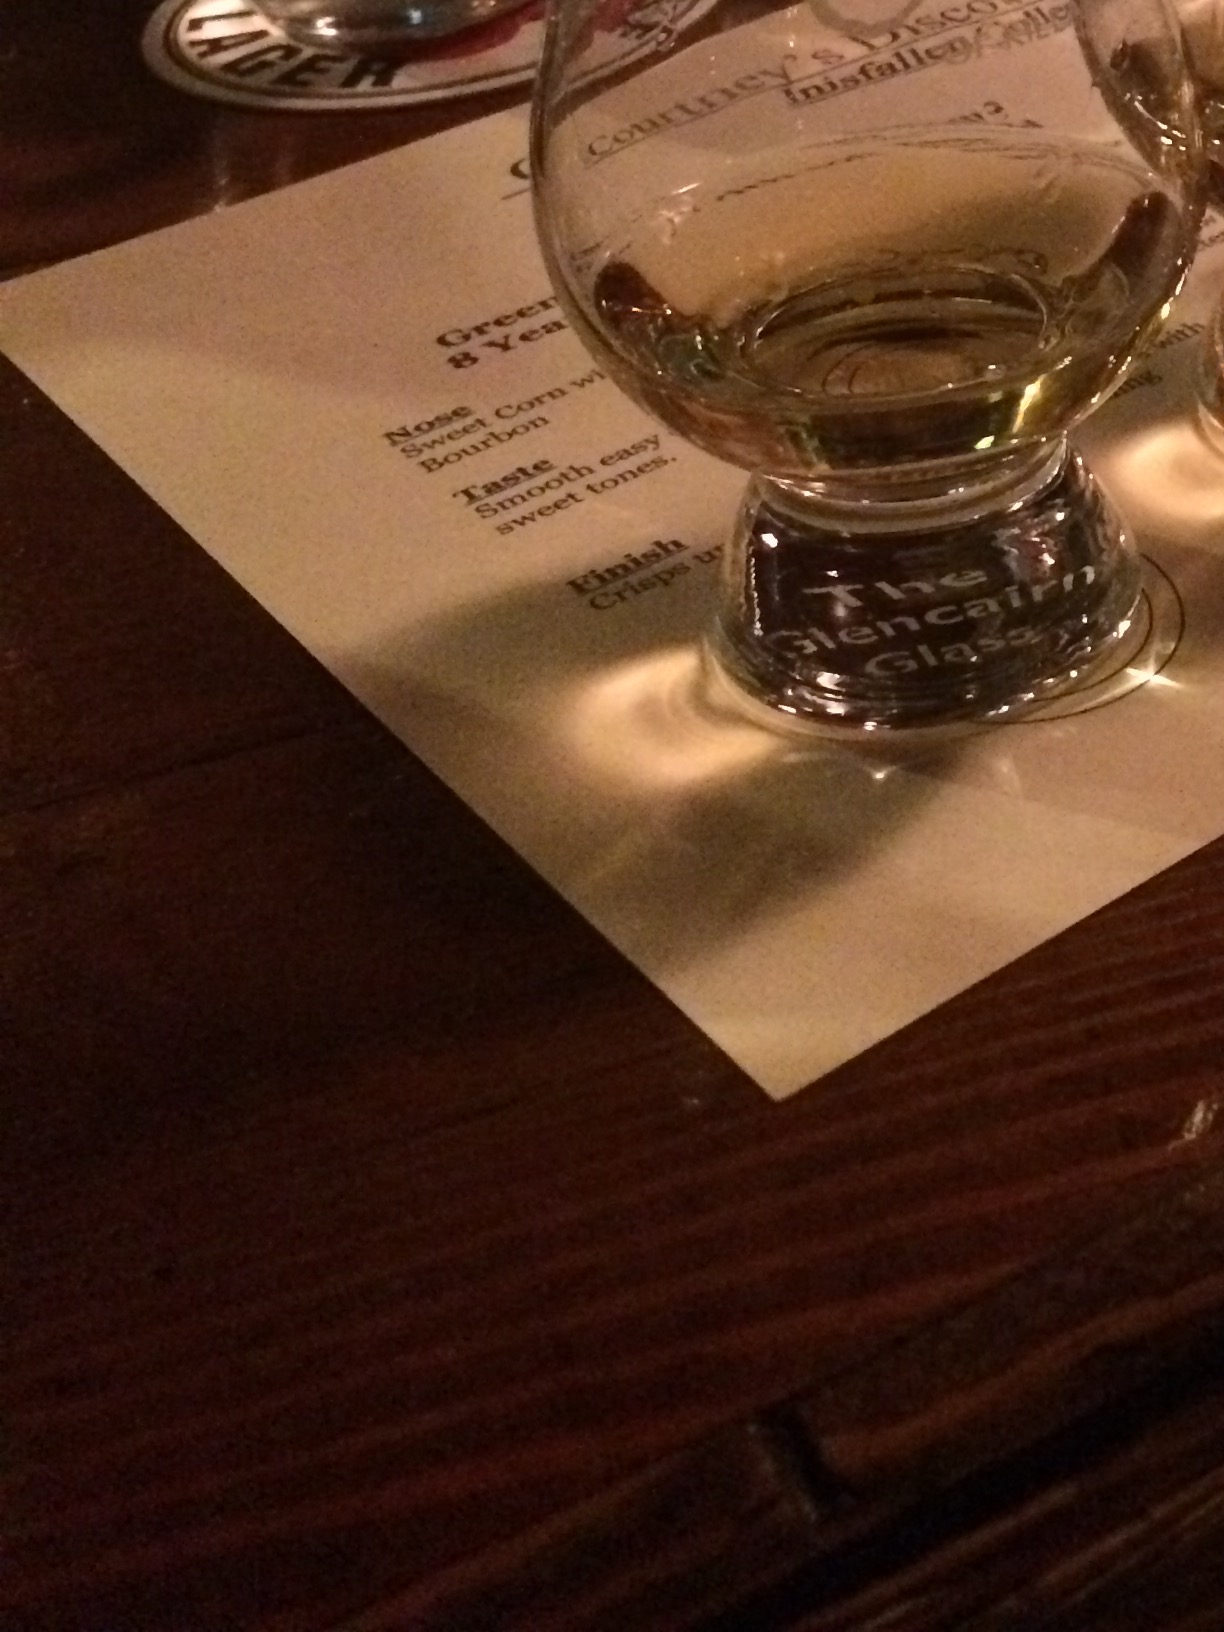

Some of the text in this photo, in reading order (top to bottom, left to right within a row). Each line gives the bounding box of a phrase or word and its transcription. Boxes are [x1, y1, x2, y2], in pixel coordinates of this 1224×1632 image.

[187, 10, 398, 89] LAGER
[447, 351, 479, 369] 8
[382, 404, 477, 446] Nose
[399, 417, 492, 459] Sweet
[494, 386, 569, 420] Corn
[416, 414, 551, 474] Bourbon
[452, 457, 557, 506] Taste
[473, 433, 662, 519] Smooth easy
[495, 454, 678, 536] sweet tones.
[565, 537, 691, 596] Finish
[802, 567, 989, 610] The
[766, 564, 1097, 659] Glencairn
[864, 623, 1037, 676] Glass
